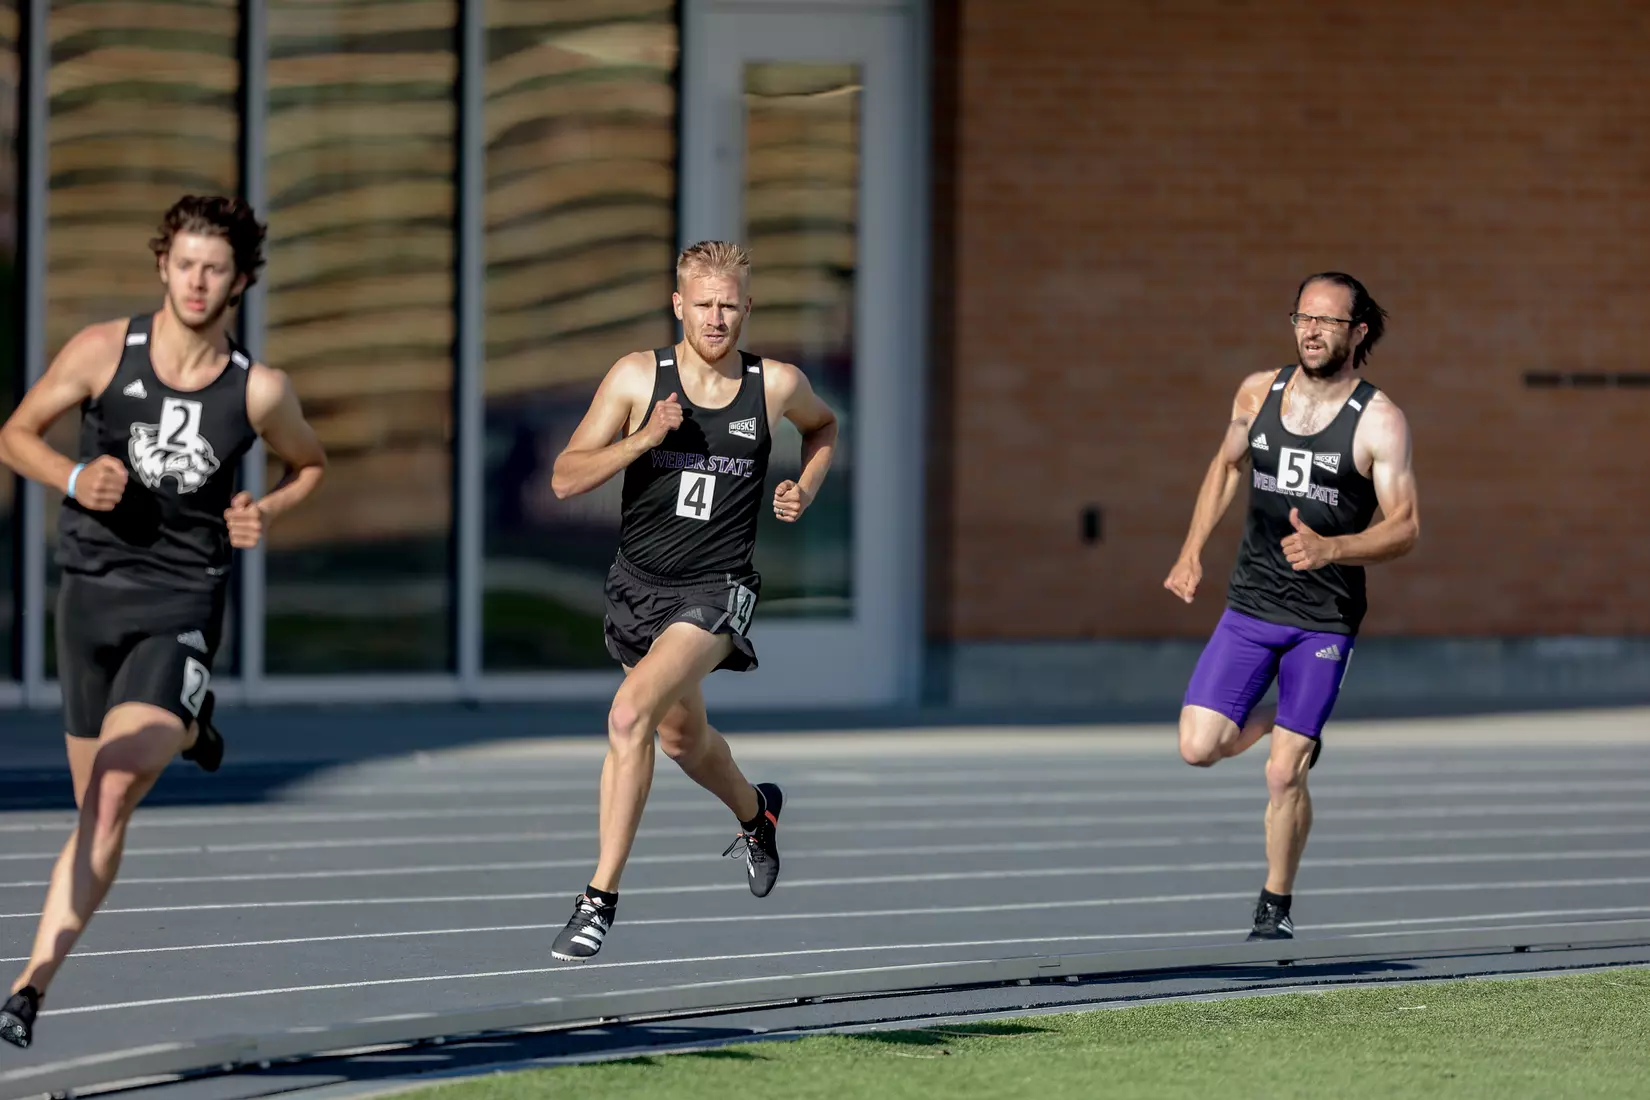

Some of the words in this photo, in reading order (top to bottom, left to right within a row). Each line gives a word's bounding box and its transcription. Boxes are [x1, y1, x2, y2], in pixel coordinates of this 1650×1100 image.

[166, 405, 191, 448] 2
[650, 449, 706, 471] WEBER
[707, 455, 755, 478] STATE
[1252, 468, 1296, 496] WEB
[1285, 452, 1304, 489] 5
[683, 476, 706, 517] 4
[188, 667, 204, 708] 2
